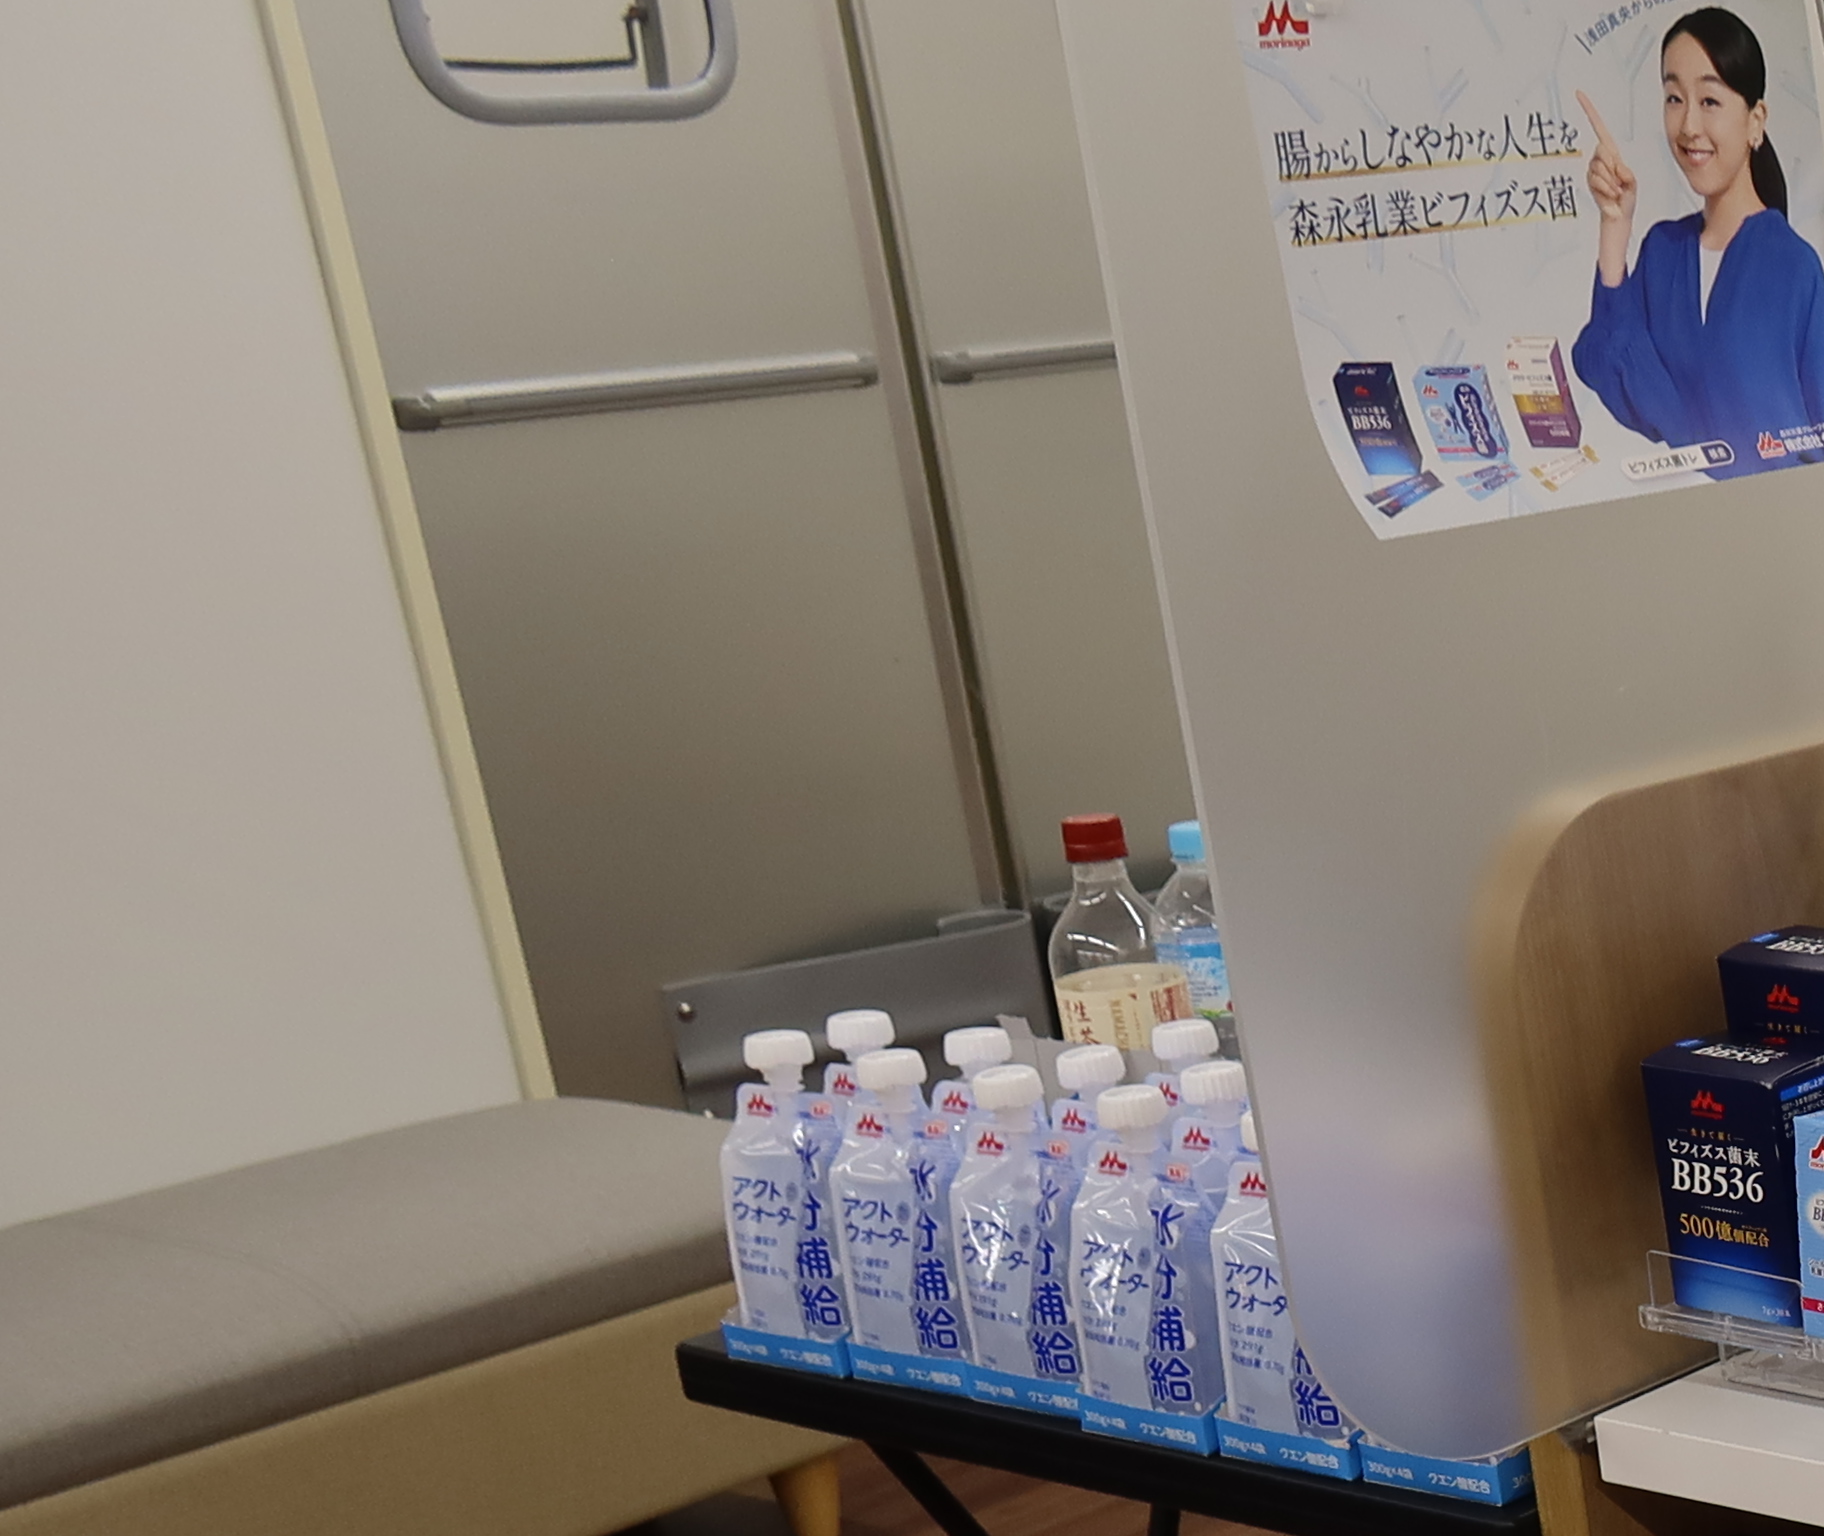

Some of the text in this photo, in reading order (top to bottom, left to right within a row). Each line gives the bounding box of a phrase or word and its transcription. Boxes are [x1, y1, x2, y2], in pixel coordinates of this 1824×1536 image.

[1274, 112, 1579, 178] 腸からしなやかな人生を
[1289, 177, 1578, 245] 森永乳業ビフィズス菌
[1667, 1137, 1762, 1169] ビフィズス菌末
[733, 1176, 782, 1200] アクト
[1671, 1159, 1764, 1203] BB536
[733, 1201, 797, 1225] ウォーター
[842, 1198, 892, 1222] アクト
[845, 1224, 910, 1246] ウォーター
[1680, 1213, 1770, 1248] 500億個配合
[909, 1160, 957, 1349] 水分補給
[1225, 1262, 1278, 1287] アクト
[1148, 1204, 1193, 1402] 水分補給
